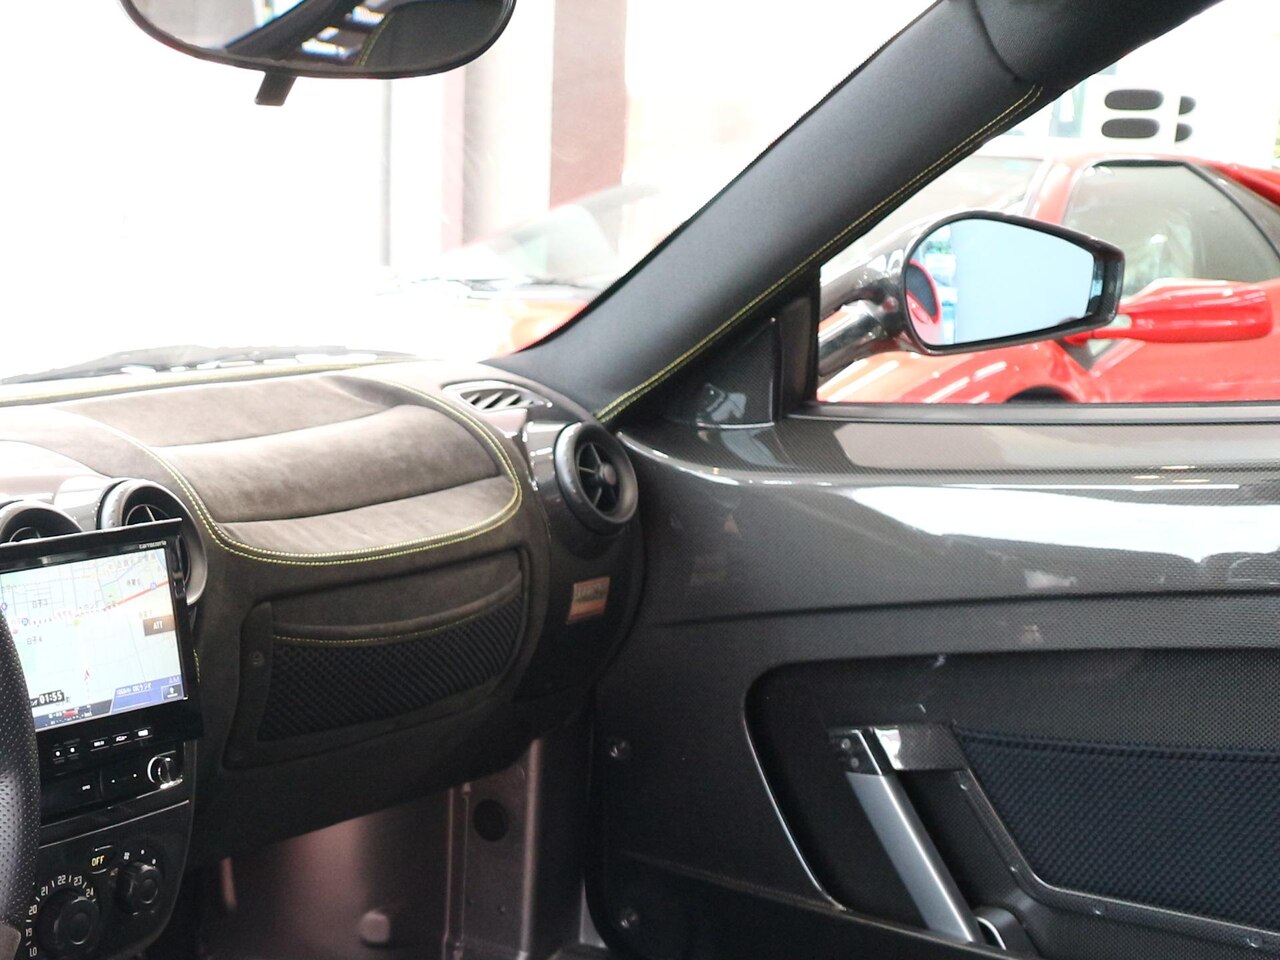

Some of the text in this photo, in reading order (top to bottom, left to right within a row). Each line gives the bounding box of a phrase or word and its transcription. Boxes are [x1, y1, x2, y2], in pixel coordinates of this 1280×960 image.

[39, 690, 63, 704] 01:55
[91, 855, 105, 866] OFF
[57, 875, 67, 885] 22
[73, 875, 83, 886] 23
[40, 885, 49, 896] 21
[86, 887, 94, 898] 24
[28, 904, 38, 916] 20
[25, 927, 33, 937] 19
